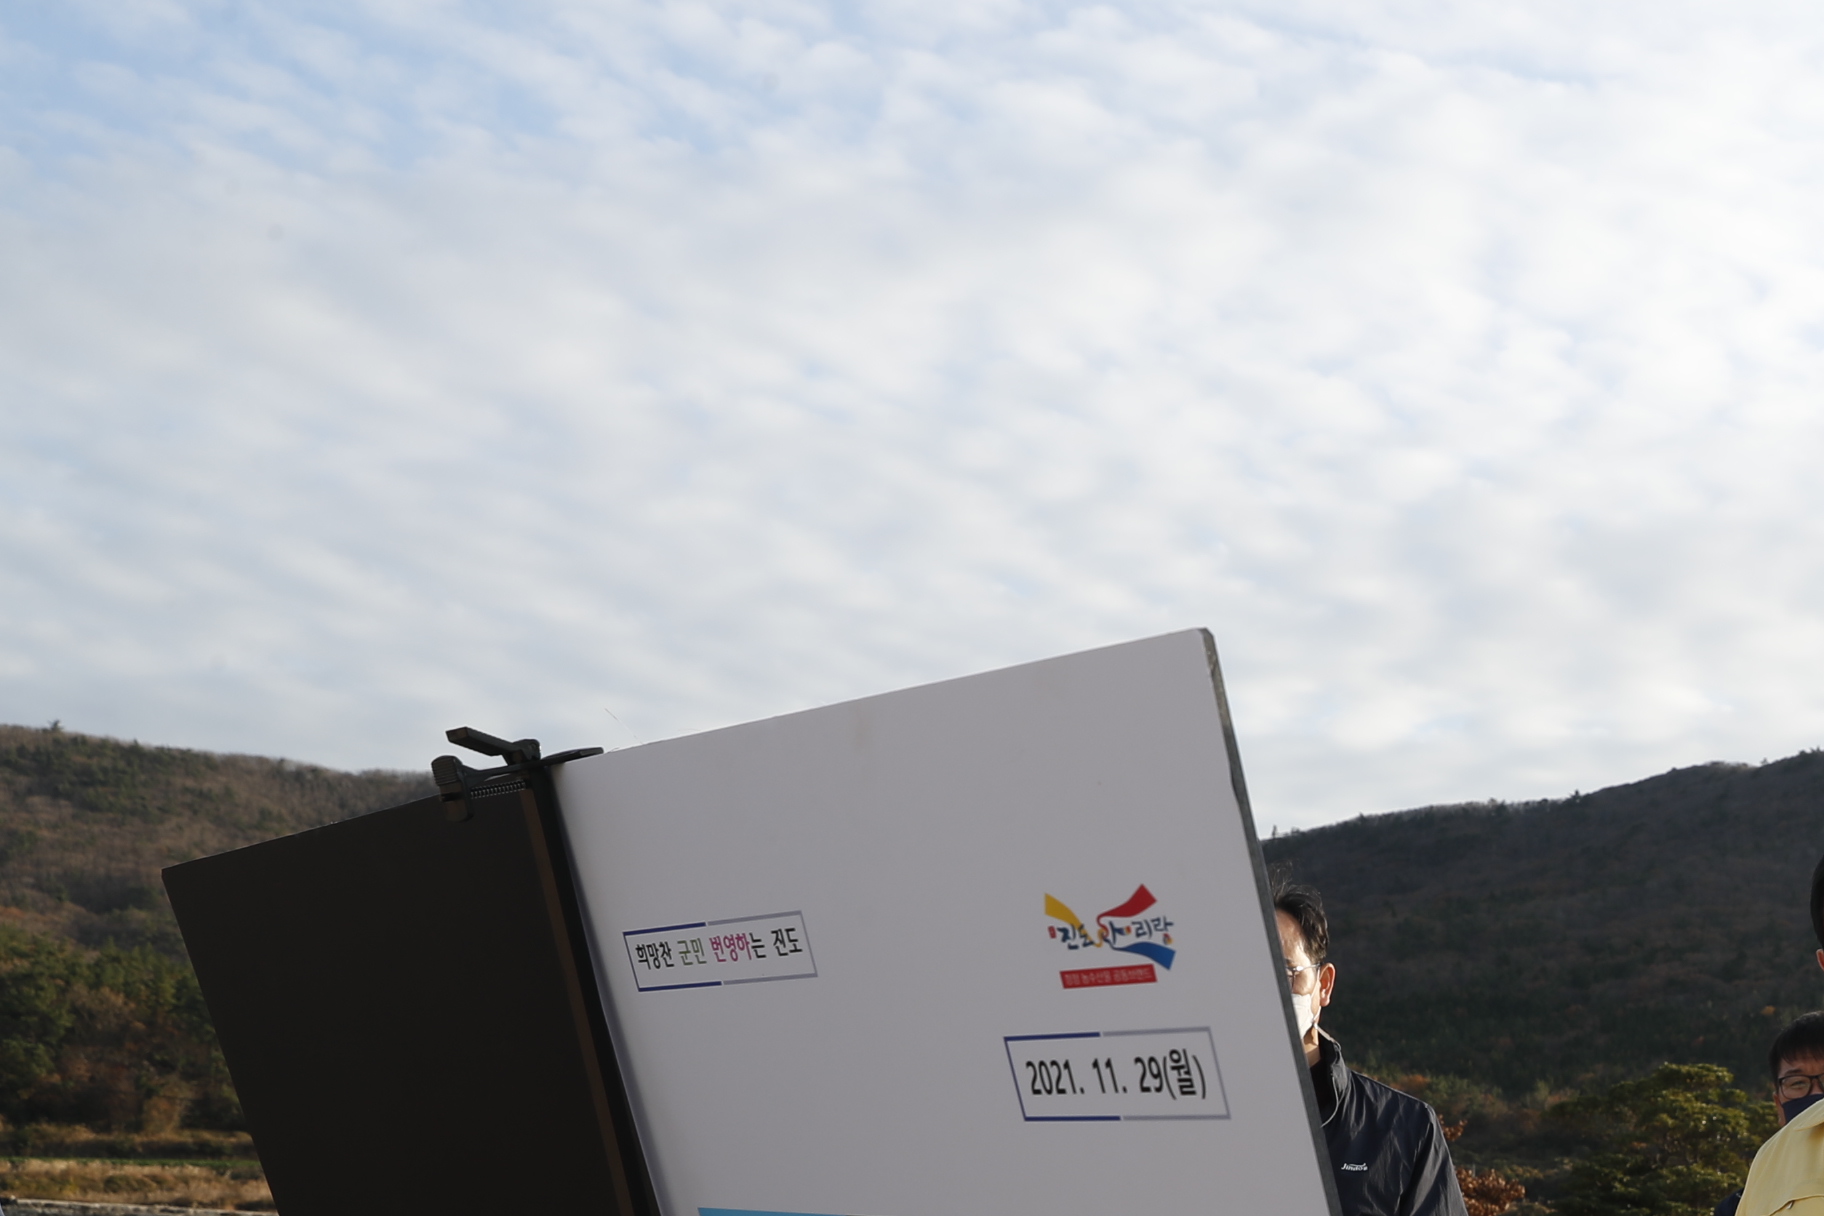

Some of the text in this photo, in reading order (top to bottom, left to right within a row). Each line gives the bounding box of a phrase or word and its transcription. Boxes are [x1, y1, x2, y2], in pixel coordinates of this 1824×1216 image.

[635, 927, 803, 970] 희망찬 군민 번영하는 진도
[1025, 1048, 1207, 1101] 2021. 11. 29(월)
